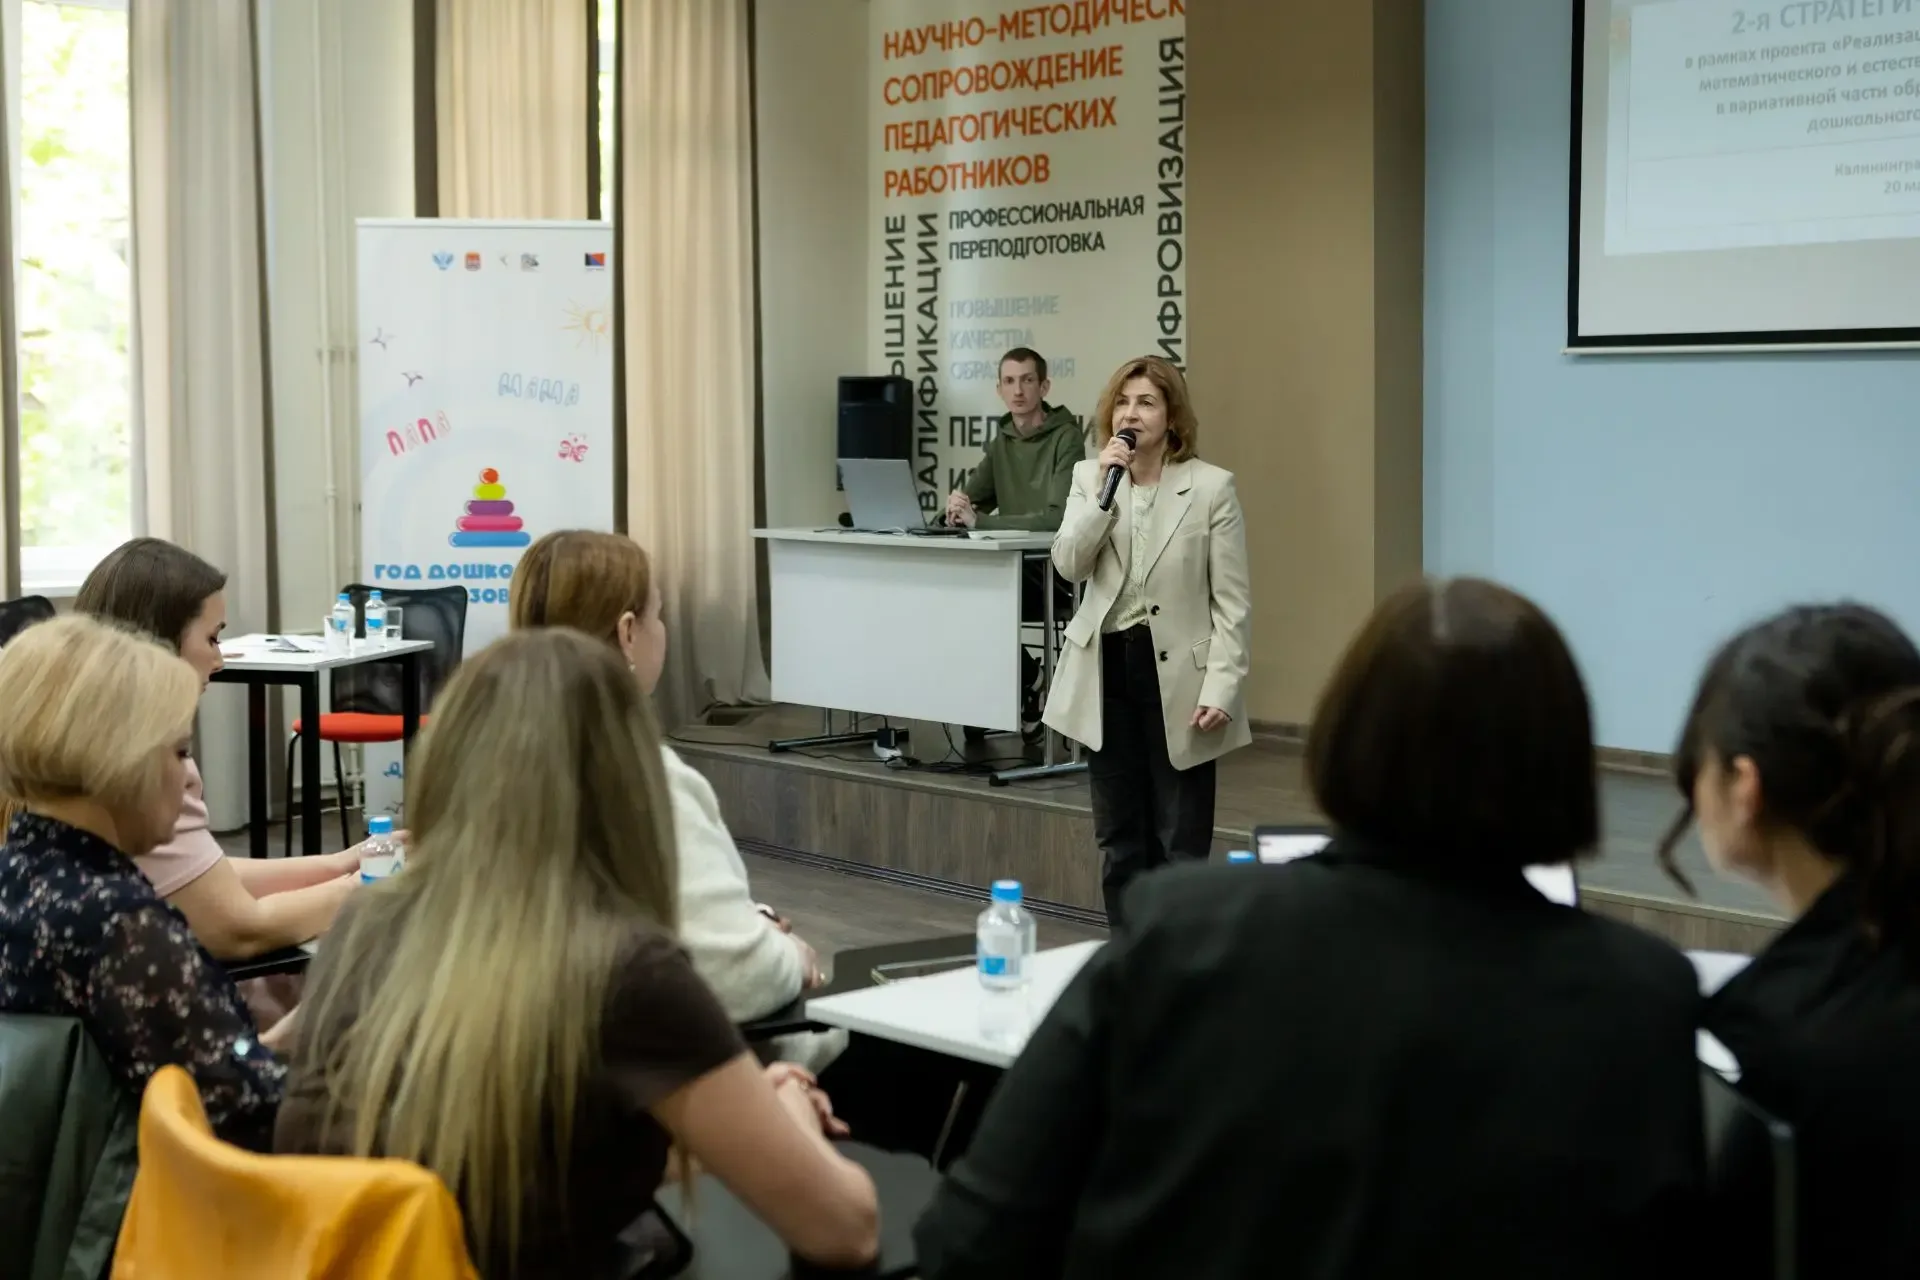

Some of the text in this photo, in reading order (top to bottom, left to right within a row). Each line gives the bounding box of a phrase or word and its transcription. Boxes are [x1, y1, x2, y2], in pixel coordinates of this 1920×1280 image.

[1732, 0, 1919, 34] 2-я СТРАТЕГИ
[1698, 49, 1756, 69] рамках
[1761, 41, 1826, 63] проекта
[884, 45, 1123, 106] СОПРОВОЖДЕНИЕ
[1700, 65, 1841, 92] математического
[1846, 62, 1857, 76] и
[1717, 103, 1725, 115] в
[1729, 87, 1836, 114] вариативной
[1841, 86, 1888, 102] части
[884, 96, 1117, 152] ПЕДАГОГИЧЕСКИХ
[1807, 109, 1920, 134] дошкольного
[884, 154, 1050, 198] РАБОТНИКОВ
[1884, 180, 1901, 195] 20
[949, 195, 1144, 230] ПРОФЕССИОНАЛЬНАЯ
[1157, 37, 1185, 372] ИФРОВИЗАЦИЯ
[949, 231, 1105, 260] ПЕРЕПОДГОТОВКА
[949, 295, 1060, 319] ПОВЫШЕНИЕ
[950, 327, 1035, 350] КАЧЕСТВА
[917, 213, 940, 512] ВАЛИФИКАЦИИ
[374, 563, 422, 579] ГОД
